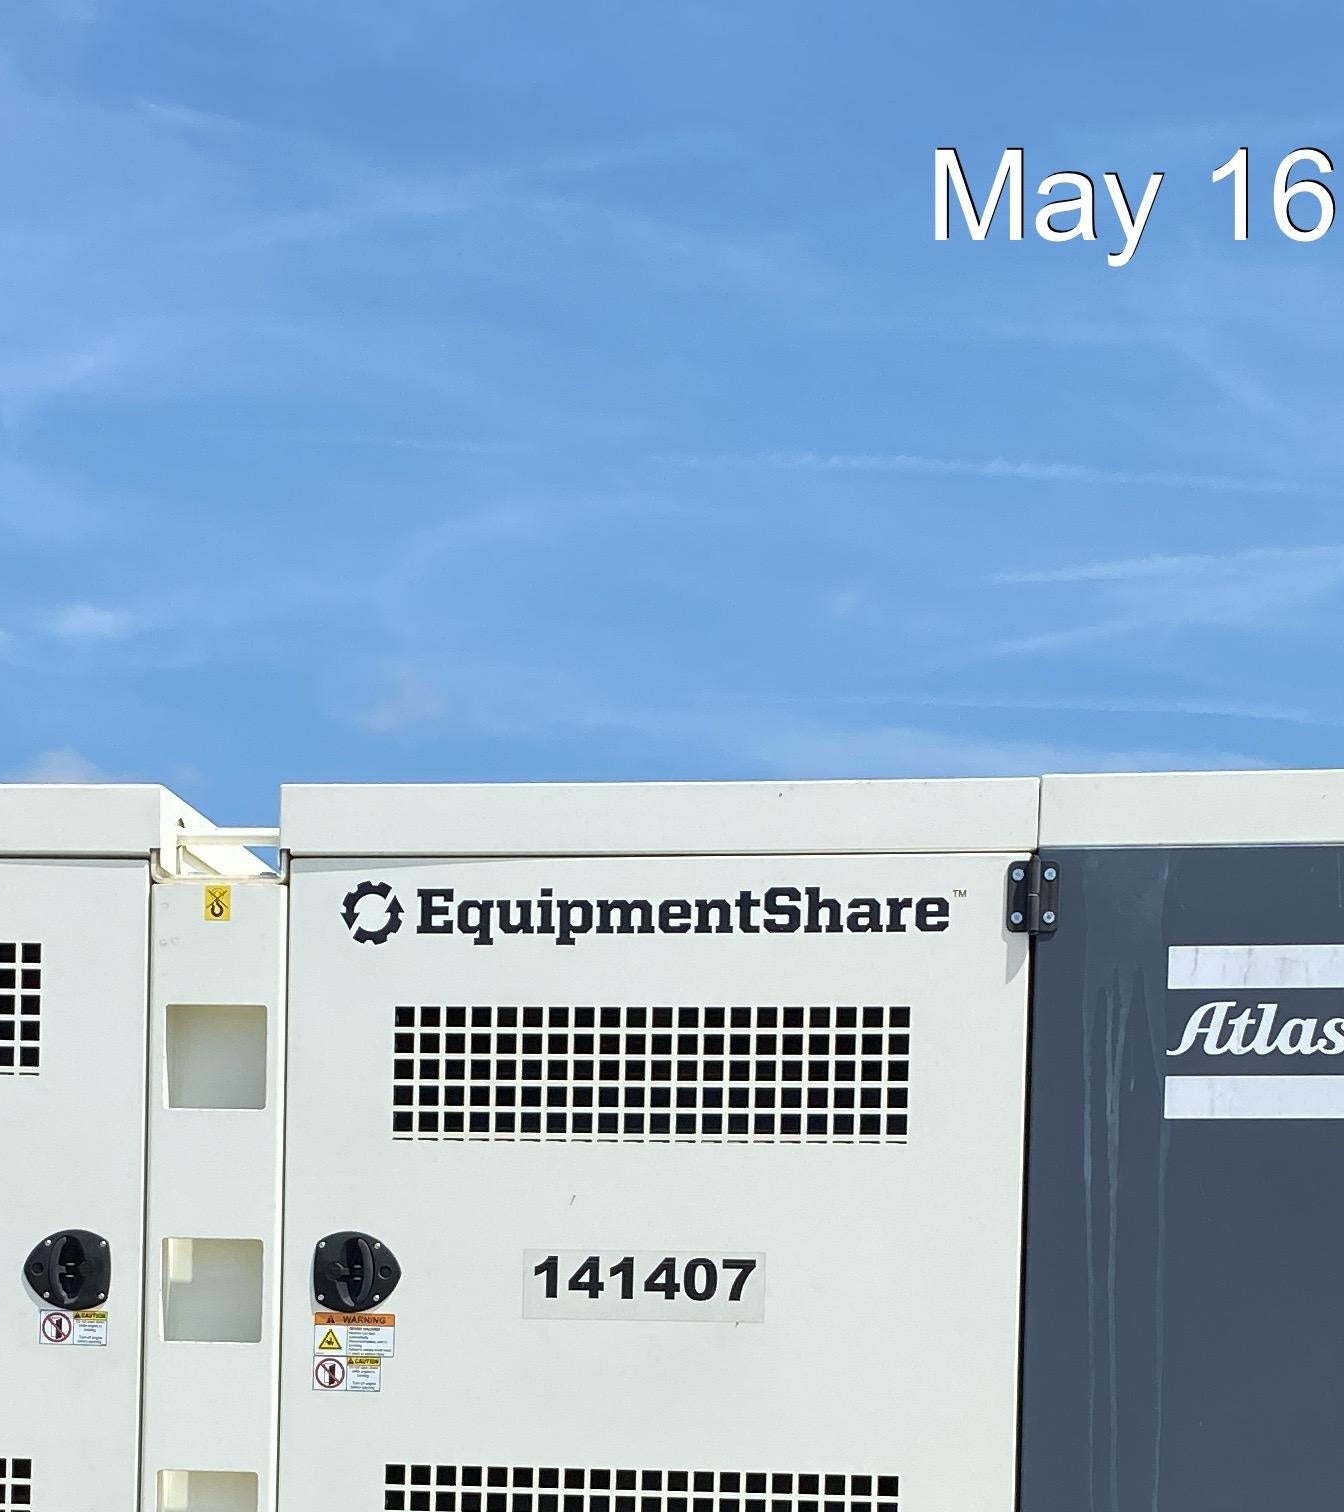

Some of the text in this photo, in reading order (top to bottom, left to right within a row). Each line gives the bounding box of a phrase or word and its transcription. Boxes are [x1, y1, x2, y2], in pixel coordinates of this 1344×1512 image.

[416, 887, 950, 946] EquipmentShare
[534, 1255, 757, 1302] 141407
[342, 1315, 387, 1325] WARNING
